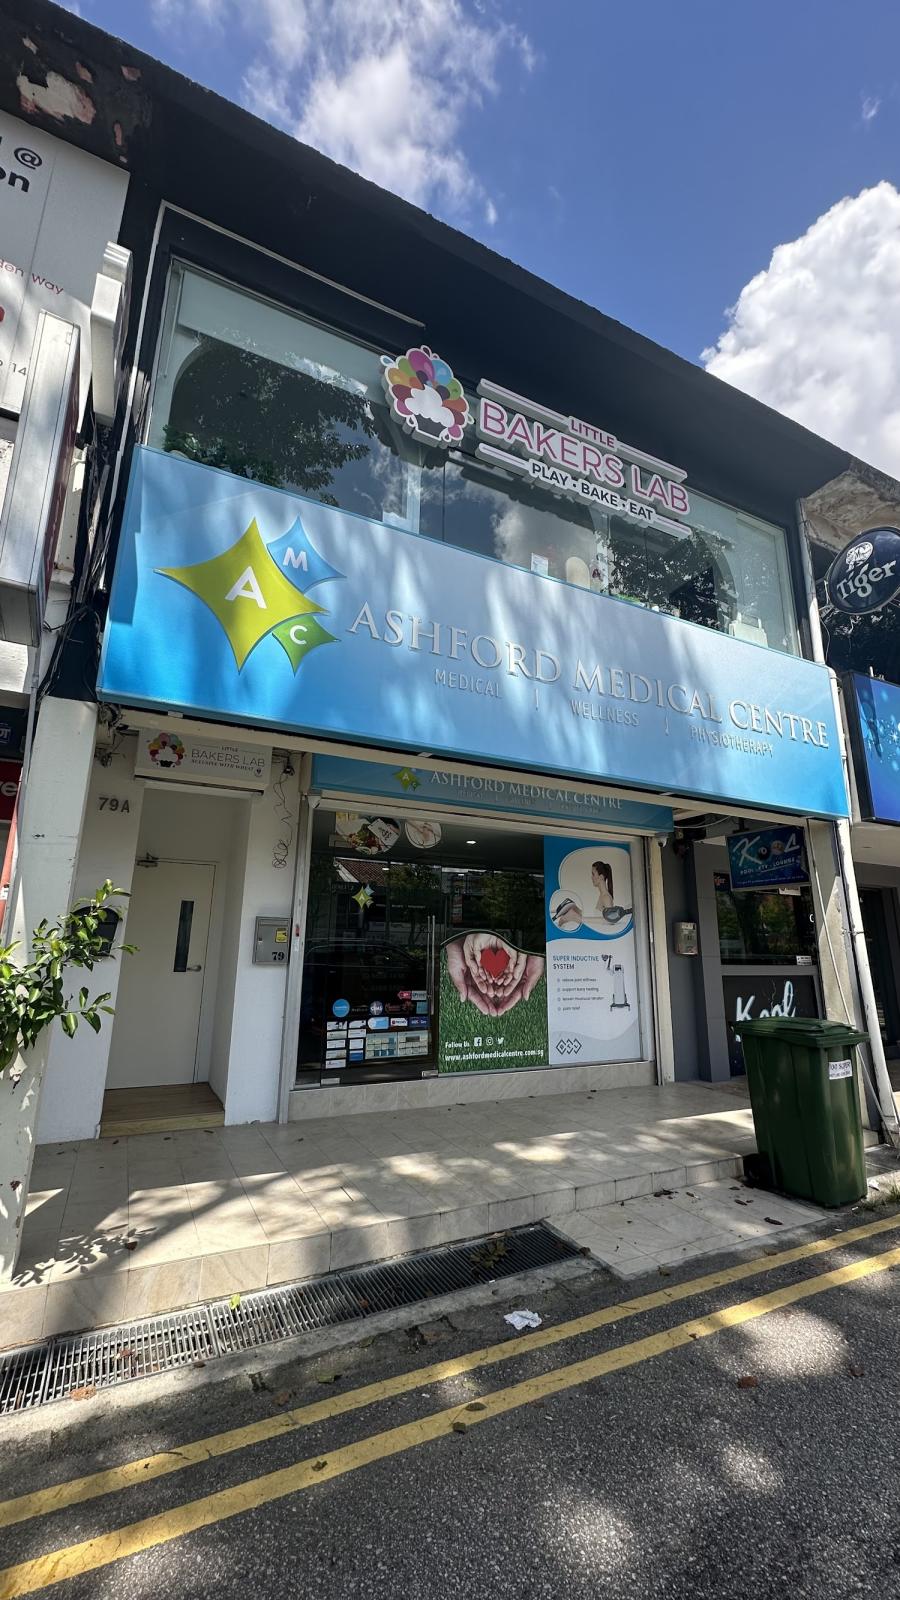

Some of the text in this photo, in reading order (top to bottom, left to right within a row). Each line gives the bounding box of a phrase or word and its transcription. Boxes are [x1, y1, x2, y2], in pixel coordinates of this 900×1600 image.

[14, 147, 43, 170] @
[32, 273, 64, 295] Way
[570, 419, 615, 450] LITTLE
[482, 401, 689, 513] BAKERS LAB
[532, 462, 654, 522] PLAY BAKE EAT
[282, 546, 309, 572] M
[224, 565, 267, 610] A
[836, 560, 897, 600] Tiger
[289, 624, 308, 645] C
[347, 600, 830, 749] ASHFORD MEDICAL CENTRE
[434, 668, 774, 759] MEDICAL WELLNESS PHYSIOTHERAPY
[191, 748, 240, 764] BAKERS
[242, 755, 265, 767] LAB
[430, 771, 505, 793] ASHFORD
[508, 782, 570, 803] MEDICAL
[573, 790, 624, 810] CENTRE
[98, 796, 130, 814] 79A
[271, 952, 285, 961] 79
[553, 954, 600, 962] SUPER INDUCTIVE
[445, 1041, 463, 1049] Follow
[445, 1049, 545, 1062] www.ashfordmedicalcentre.com.sg
